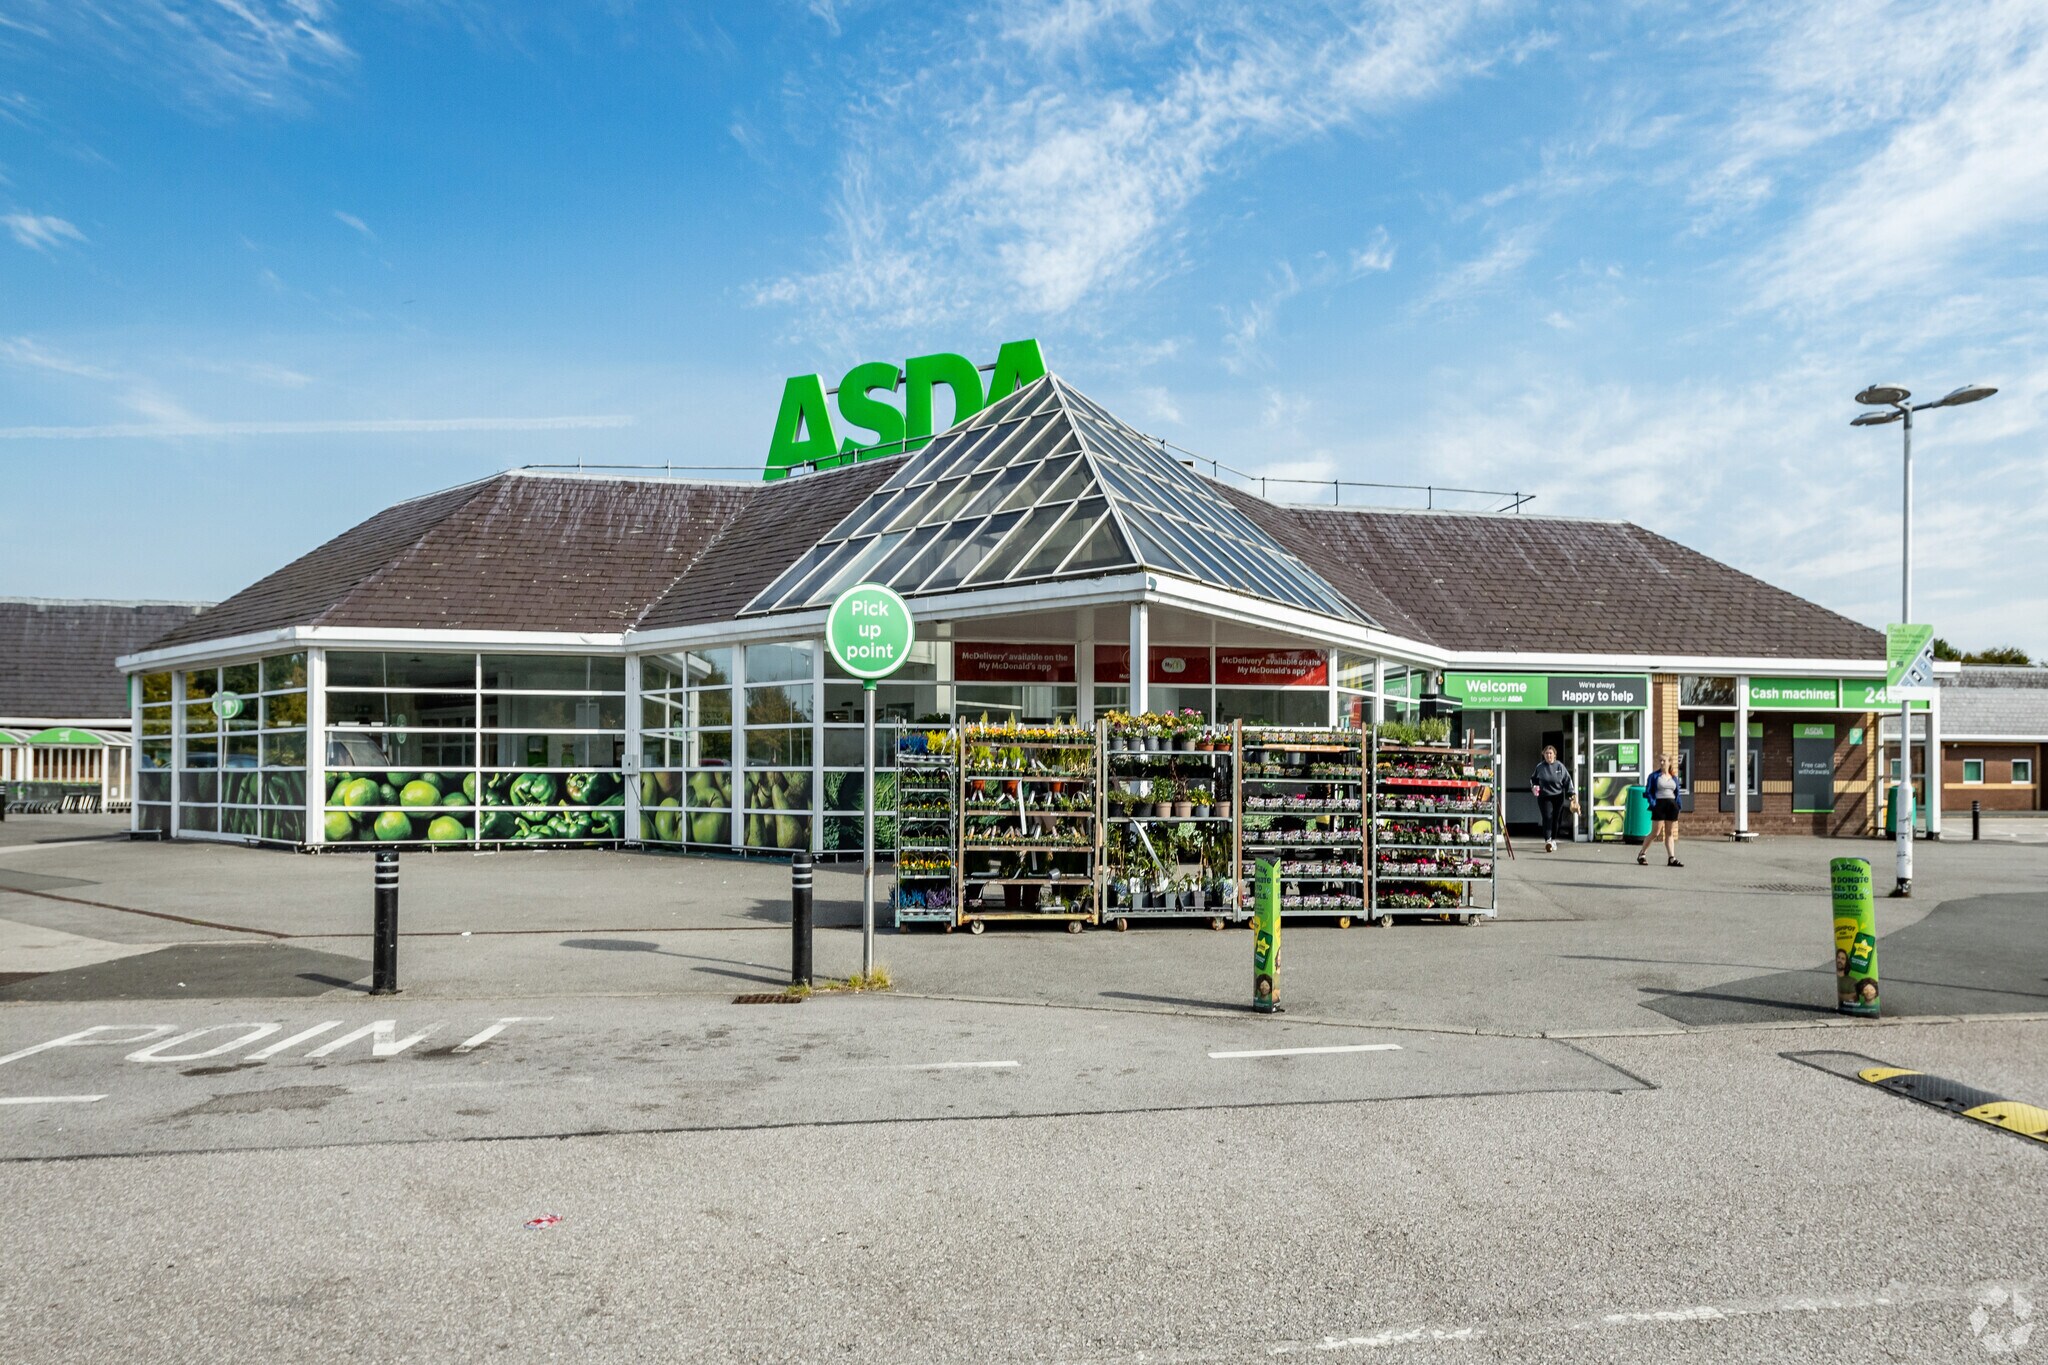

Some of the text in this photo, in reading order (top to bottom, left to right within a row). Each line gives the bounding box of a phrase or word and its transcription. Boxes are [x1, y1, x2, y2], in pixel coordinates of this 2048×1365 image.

[763, 338, 1048, 481] ASDA
[852, 600, 889, 616] Pick
[859, 624, 881, 640] up
[847, 642, 893, 660] point
[1009, 652, 1043, 661] available
[1055, 653, 1068, 661] the
[979, 662, 1052, 672] My McDonald's app
[1266, 657, 1297, 666] available
[1237, 666, 1306, 677] My McDonald's app
[1466, 679, 1527, 693] Welcome
[1579, 681, 1615, 690] We're always
[1562, 690, 1634, 703] Happy to help
[1751, 687, 1836, 700] Cash machines
[1804, 727, 1824, 736] ASDA
[0, 1016, 554, 1064] POINT
